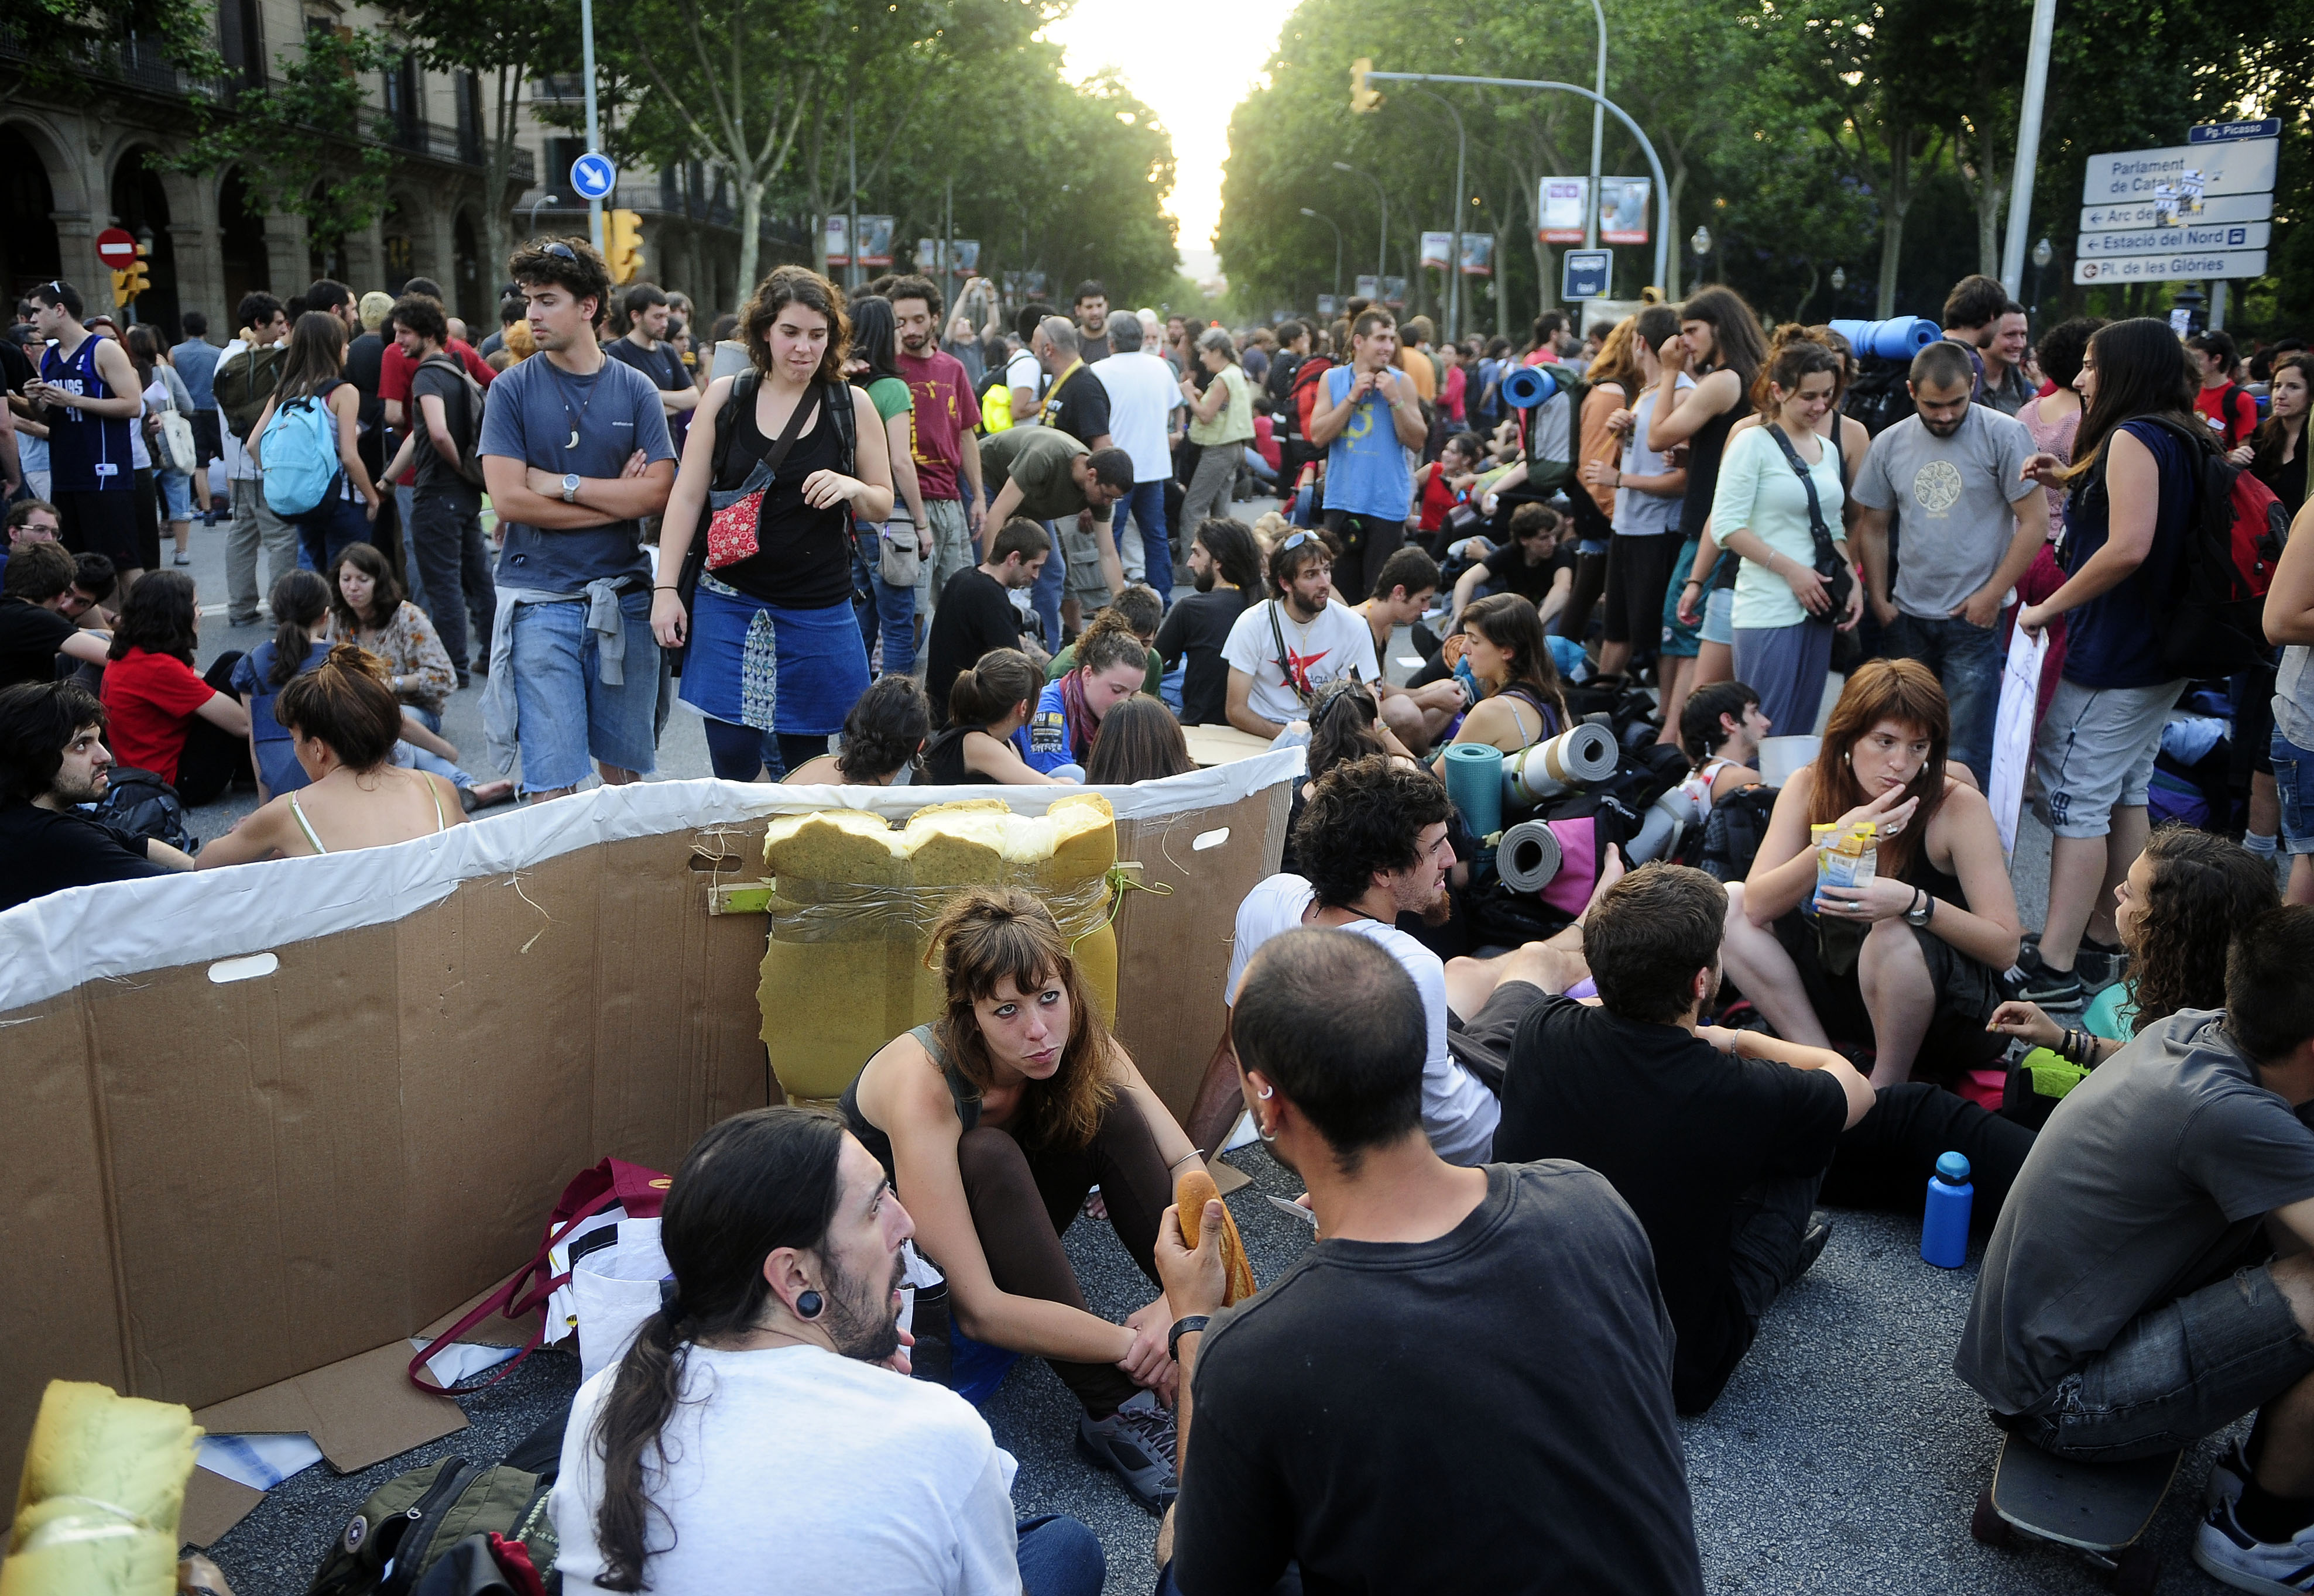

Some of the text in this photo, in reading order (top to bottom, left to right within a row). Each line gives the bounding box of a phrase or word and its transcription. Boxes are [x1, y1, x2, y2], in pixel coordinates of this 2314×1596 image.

[2206, 125, 2262, 138] Pg. Picasso
[2112, 157, 2184, 174] Parlament
[2110, 180, 2127, 193] de
[2107, 207, 2154, 222] Arc de
[2103, 229, 2224, 250] Estació del Nord
[2101, 258, 2224, 275] Pl. de les Glòries
